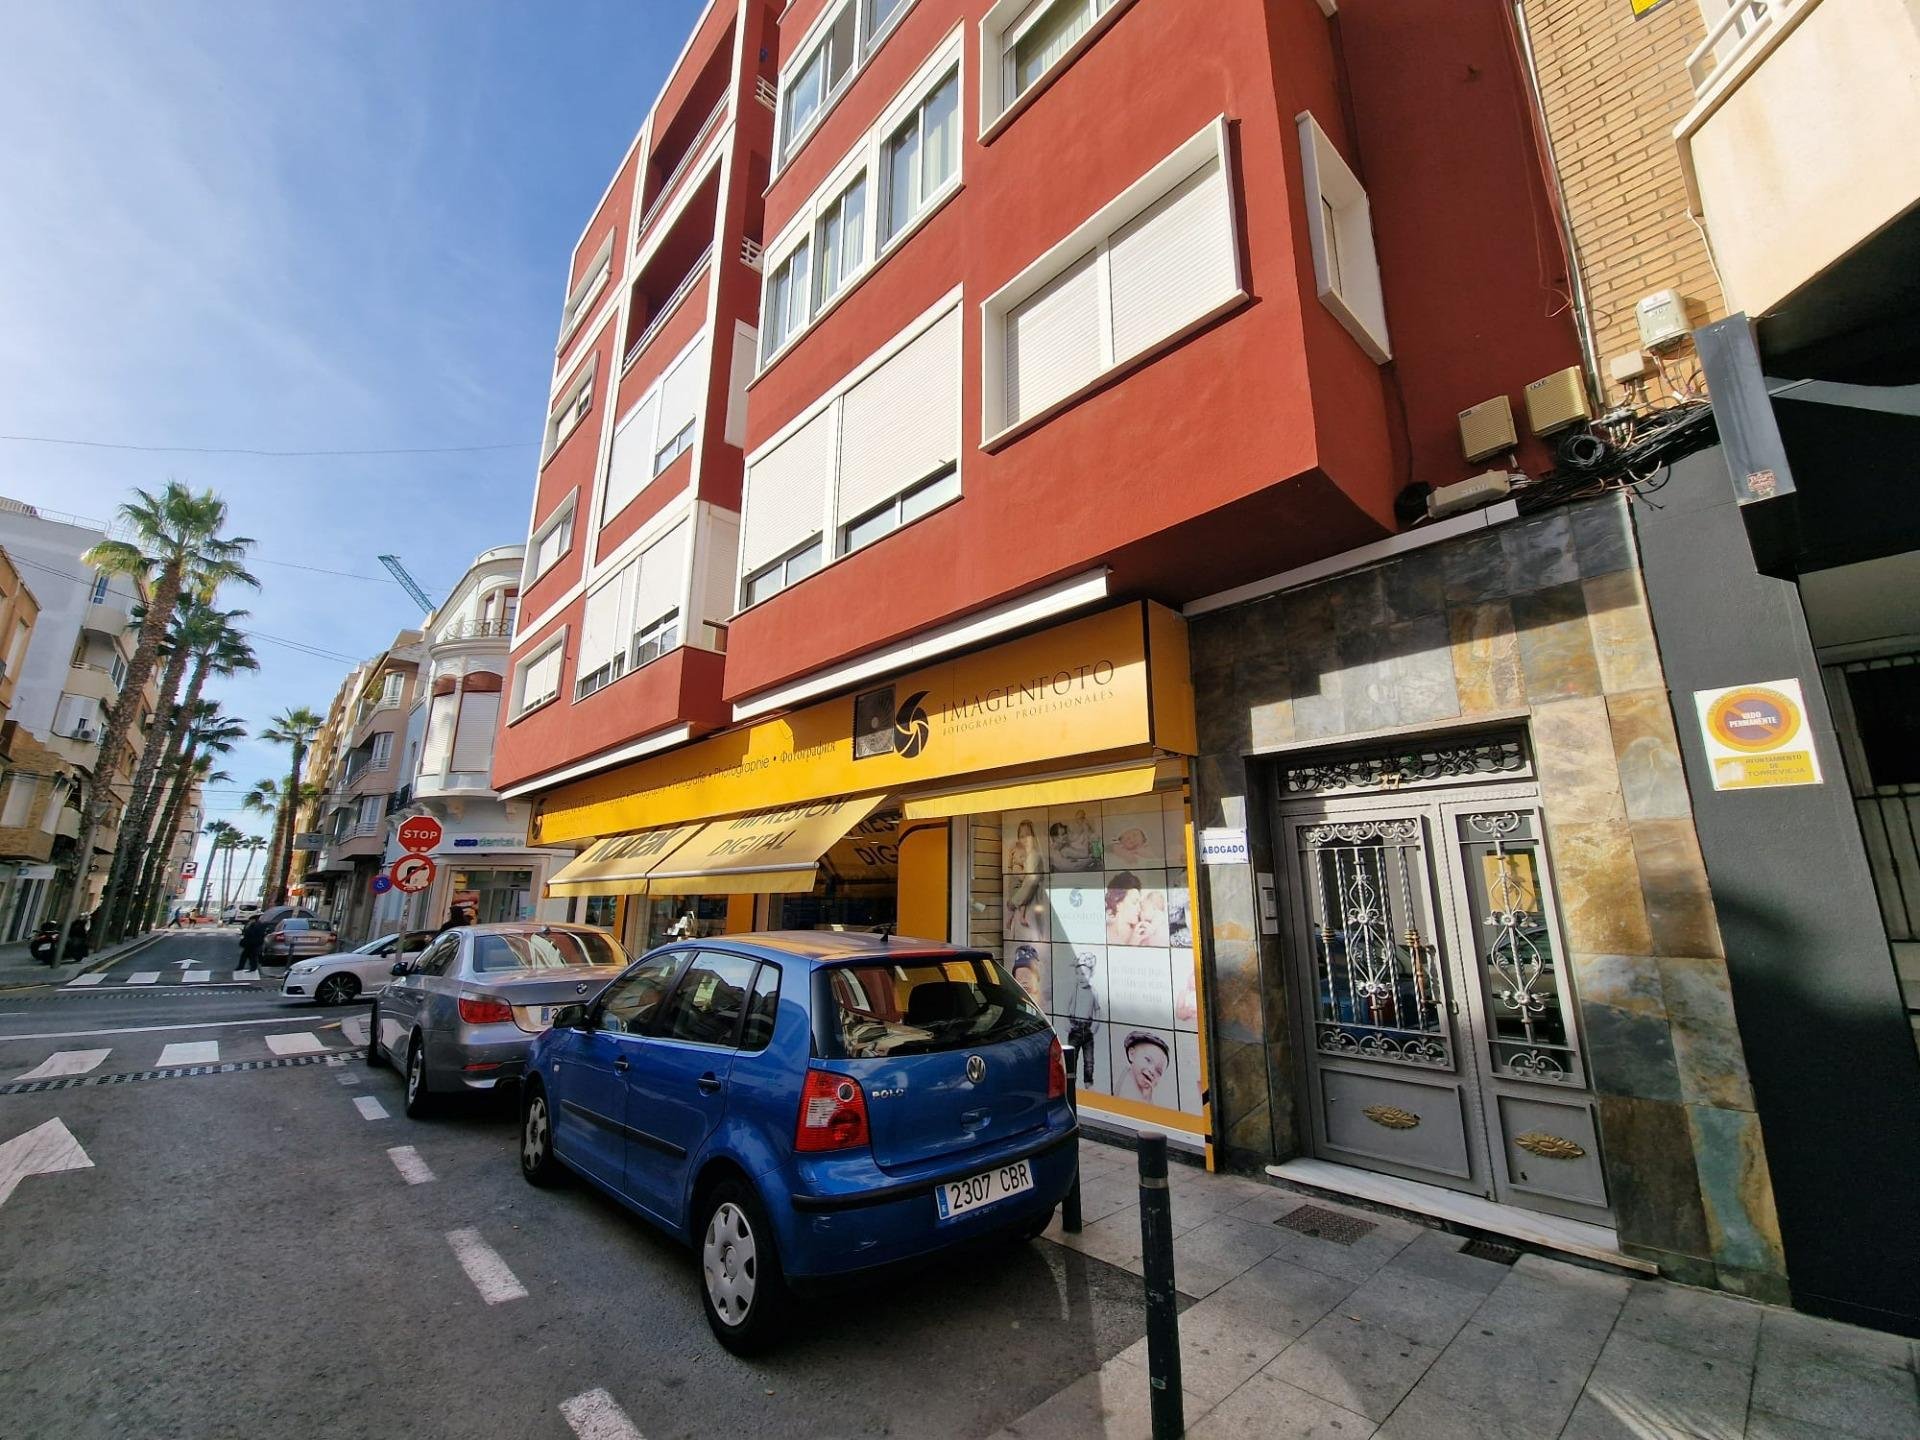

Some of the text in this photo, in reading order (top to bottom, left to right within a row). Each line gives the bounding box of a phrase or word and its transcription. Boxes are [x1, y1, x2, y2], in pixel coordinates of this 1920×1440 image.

[942, 659, 1114, 724] IMAGENFOTO
[1741, 711, 1762, 720] VADO
[1729, 716, 1778, 729] PERMANENTE
[403, 829, 438, 840] STOP
[707, 829, 797, 857] DIGITAL
[1202, 844, 1245, 855] ABOGADO
[872, 1088, 904, 1100] POLO
[951, 1164, 1029, 1210] 2307 CBR
